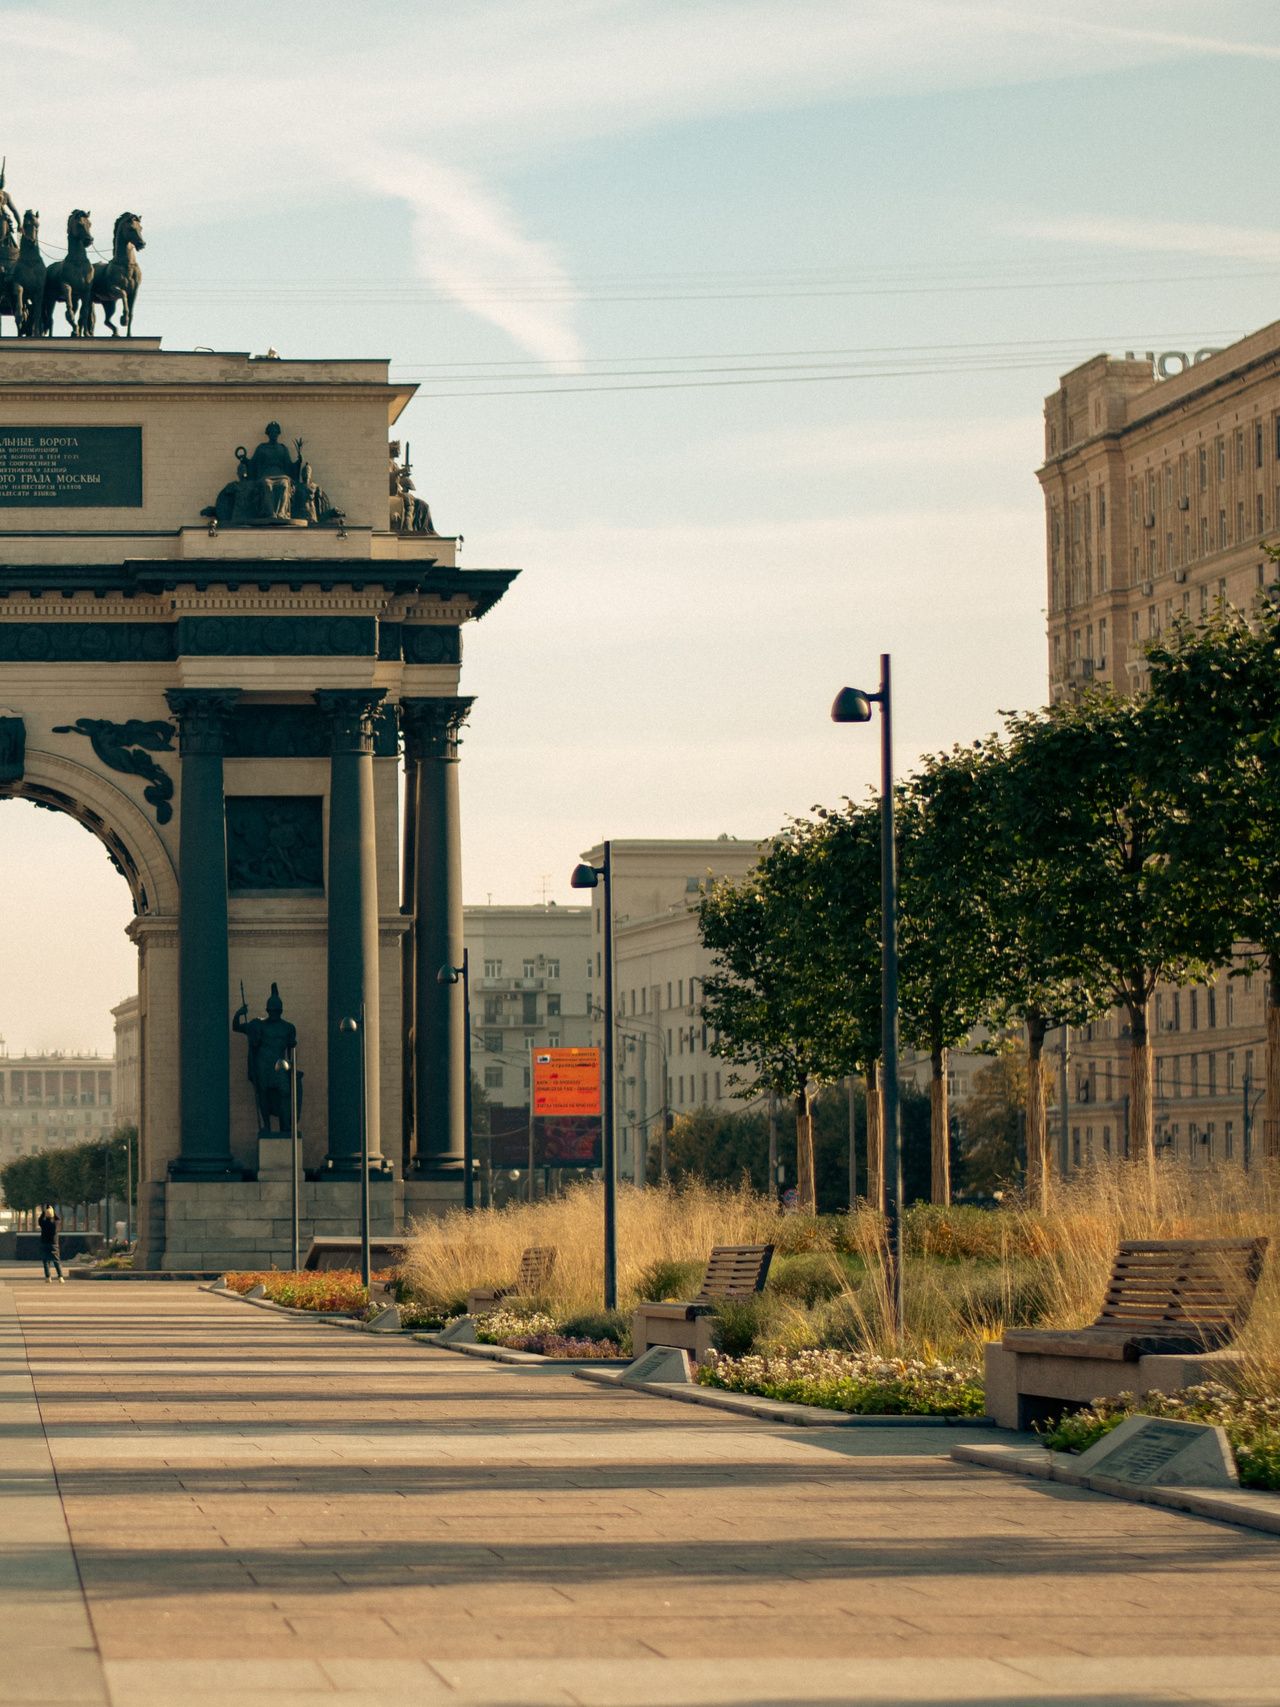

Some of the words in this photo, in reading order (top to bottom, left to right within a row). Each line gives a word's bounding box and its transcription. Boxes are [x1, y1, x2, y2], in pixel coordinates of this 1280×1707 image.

[39, 437, 79, 447] ВОРОТА
[21, 473, 51, 483] ГРАДА
[56, 473, 101, 483] МОСКВЫ
